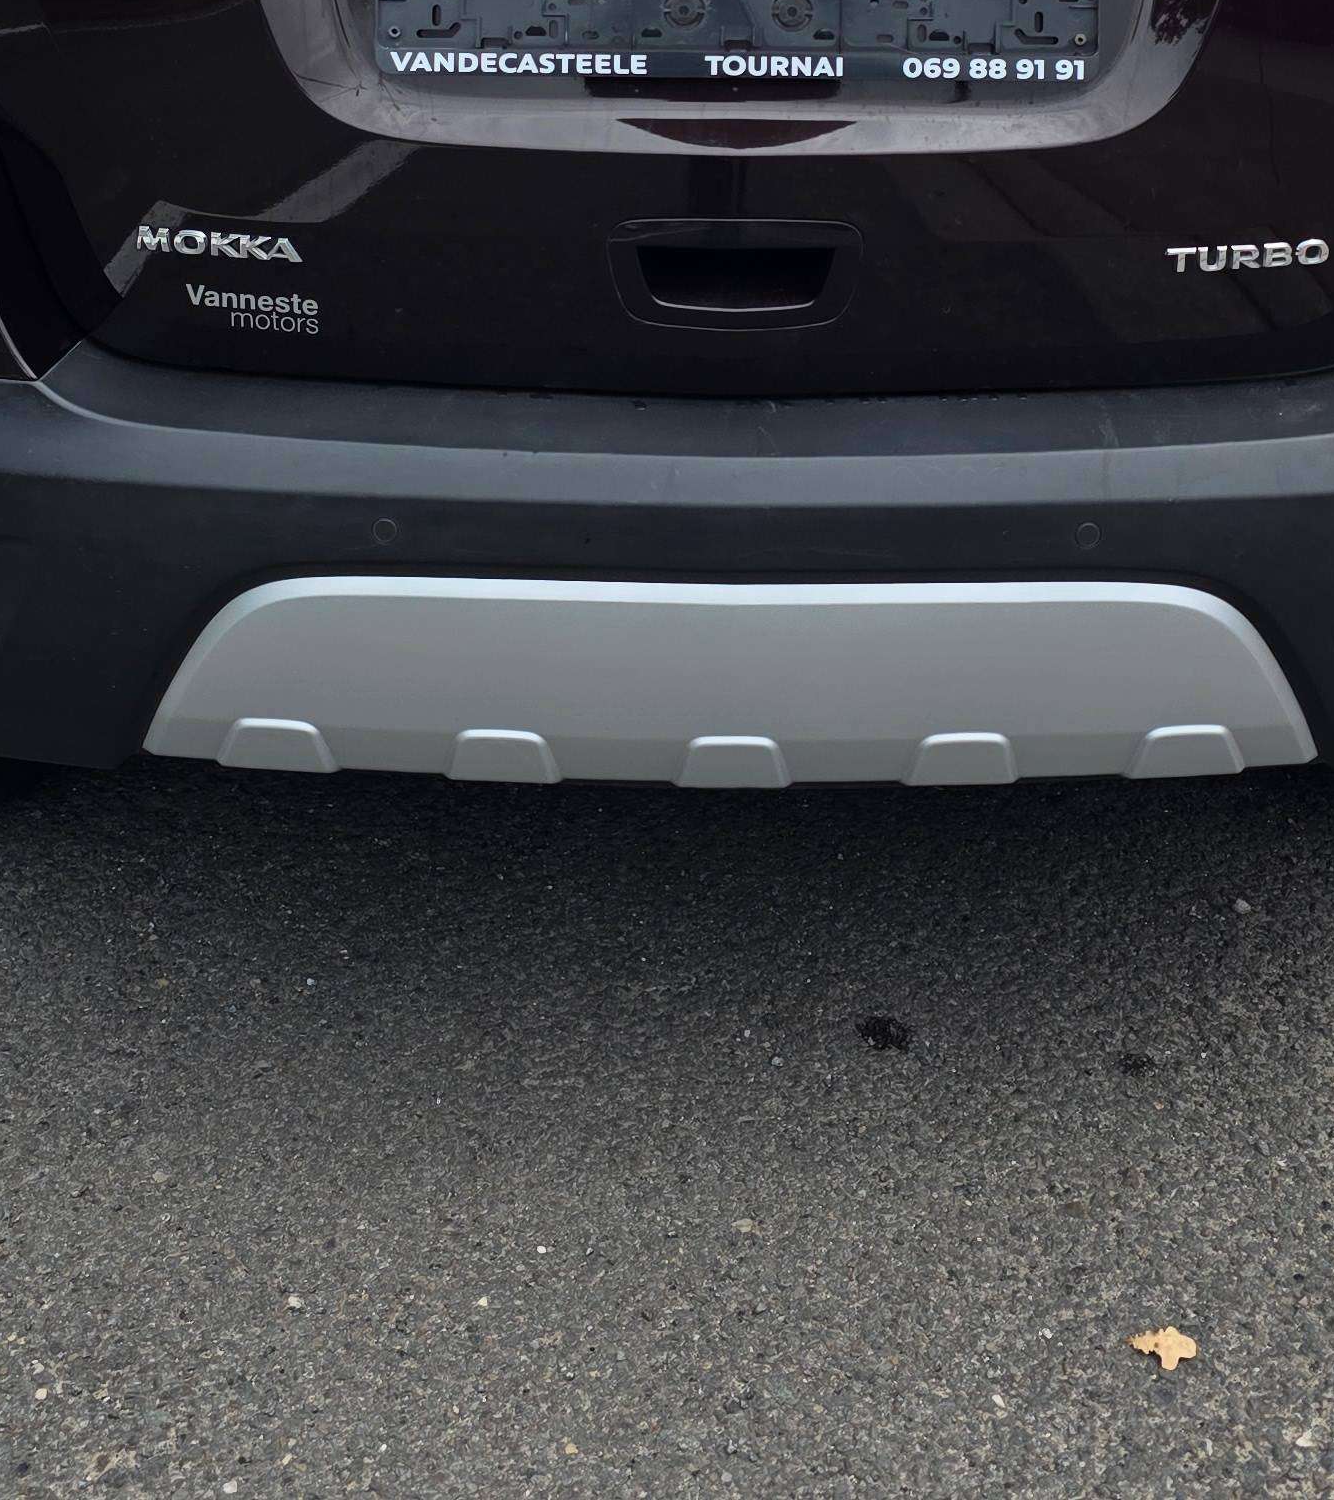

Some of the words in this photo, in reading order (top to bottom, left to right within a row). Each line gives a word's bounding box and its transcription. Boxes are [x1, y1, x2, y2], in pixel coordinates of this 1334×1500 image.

[389, 51, 648, 75] VANDECASTEELE
[704, 54, 844, 77] TOURNAI
[902, 57, 961, 79] 069
[968, 58, 1008, 80] 88
[1015, 58, 1046, 80] 91
[1055, 59, 1085, 81] 91
[136, 225, 303, 263] MOKKA
[1165, 238, 1330, 273] TURBO
[185, 283, 319, 316] Vanneste
[230, 311, 319, 335] motors
